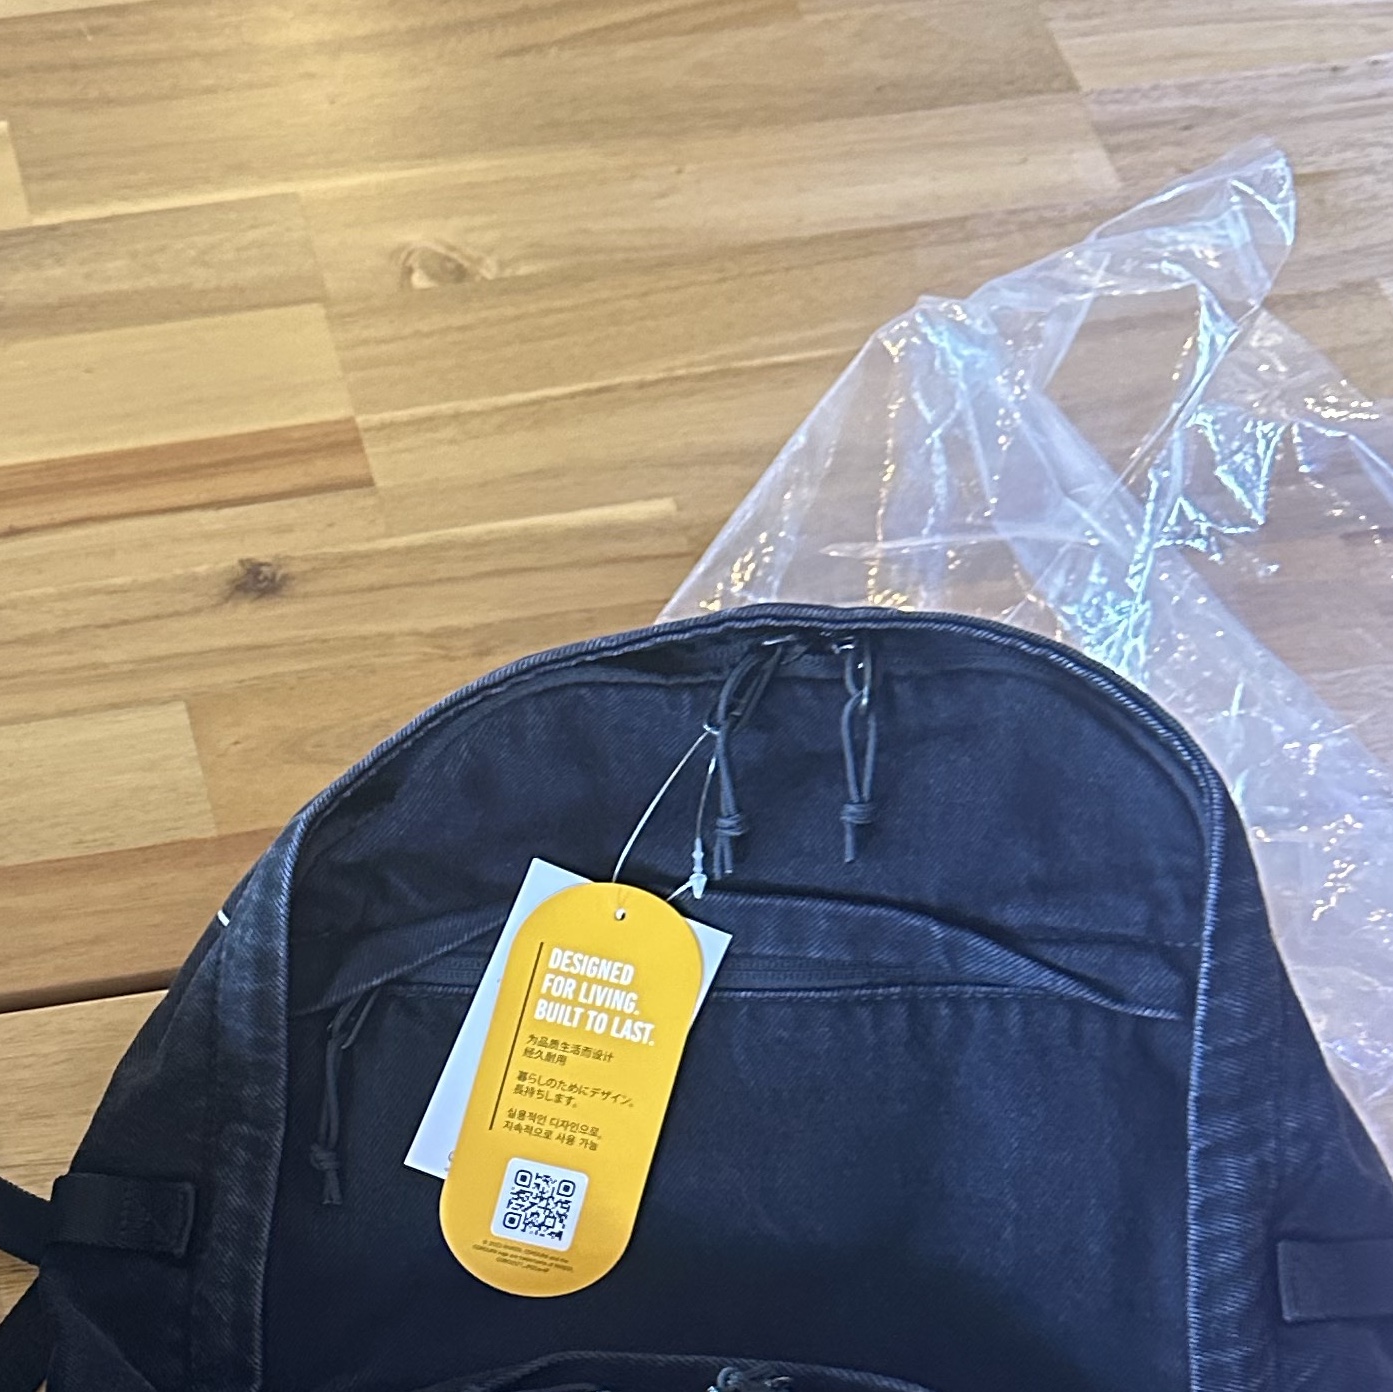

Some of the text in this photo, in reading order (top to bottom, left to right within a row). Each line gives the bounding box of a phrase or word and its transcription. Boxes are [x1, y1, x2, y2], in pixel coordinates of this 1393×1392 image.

[548, 947, 635, 985] DESIGNED
[540, 973, 640, 1016] FOR LIVING.
[533, 998, 656, 1046] BUILT TO LAST.
[554, 1132, 576, 1146] 사용
